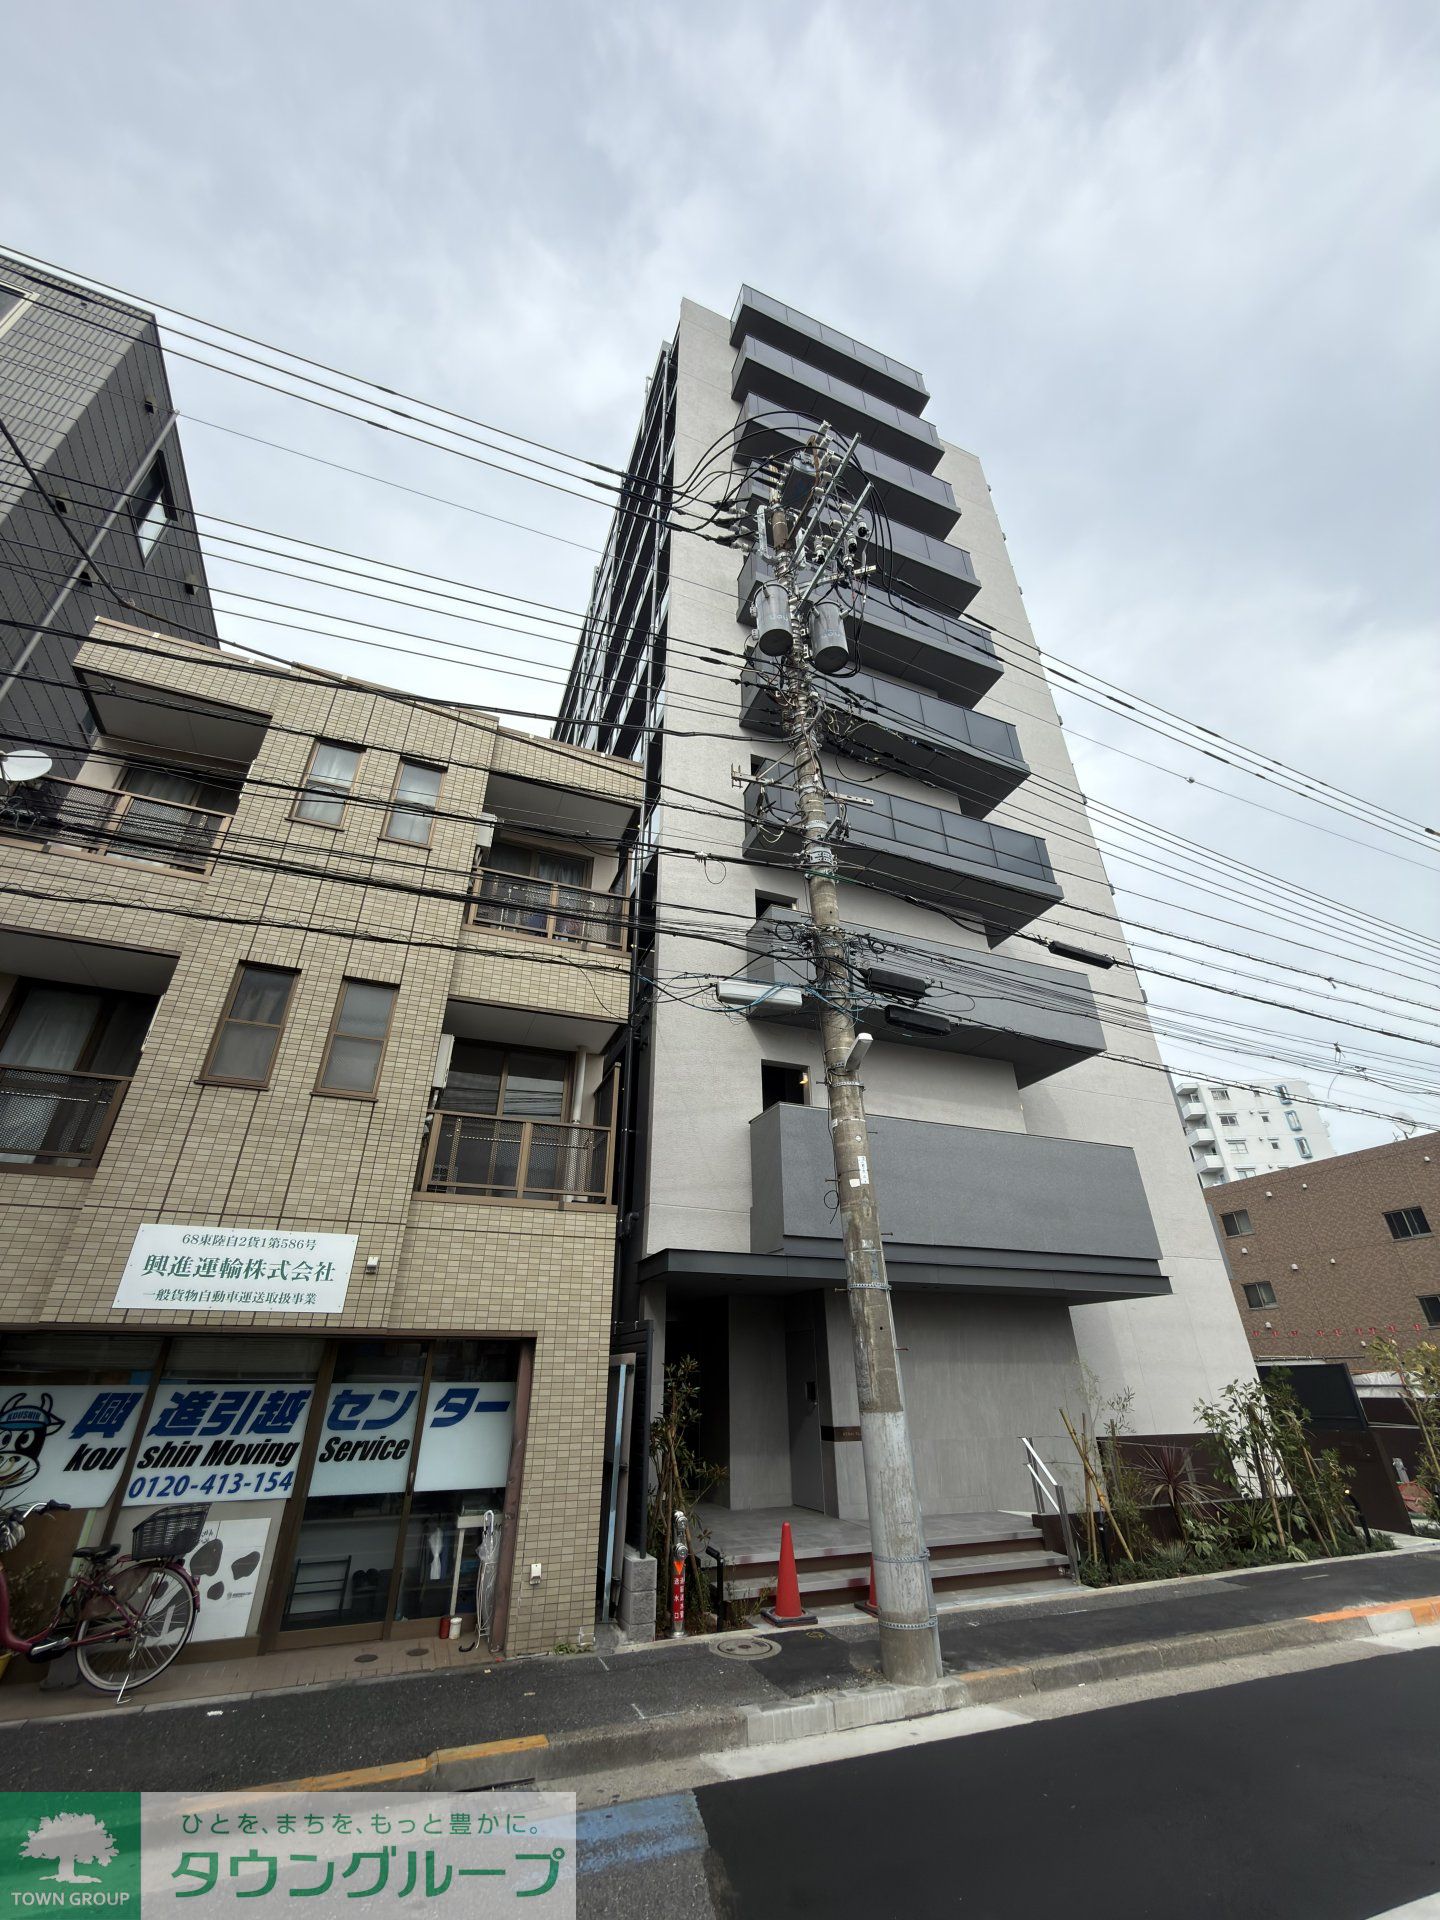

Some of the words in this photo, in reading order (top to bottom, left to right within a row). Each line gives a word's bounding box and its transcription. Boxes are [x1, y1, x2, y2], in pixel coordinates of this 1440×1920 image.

[141, 1254, 336, 1282] 興進運輸株式会社
[143, 1288, 318, 1305] 一般貨物自動車運送取扱事業
[199, 1438, 301, 1467] Moving
[318, 1435, 411, 1463] Service
[128, 1470, 295, 1499] 0120-413-154
